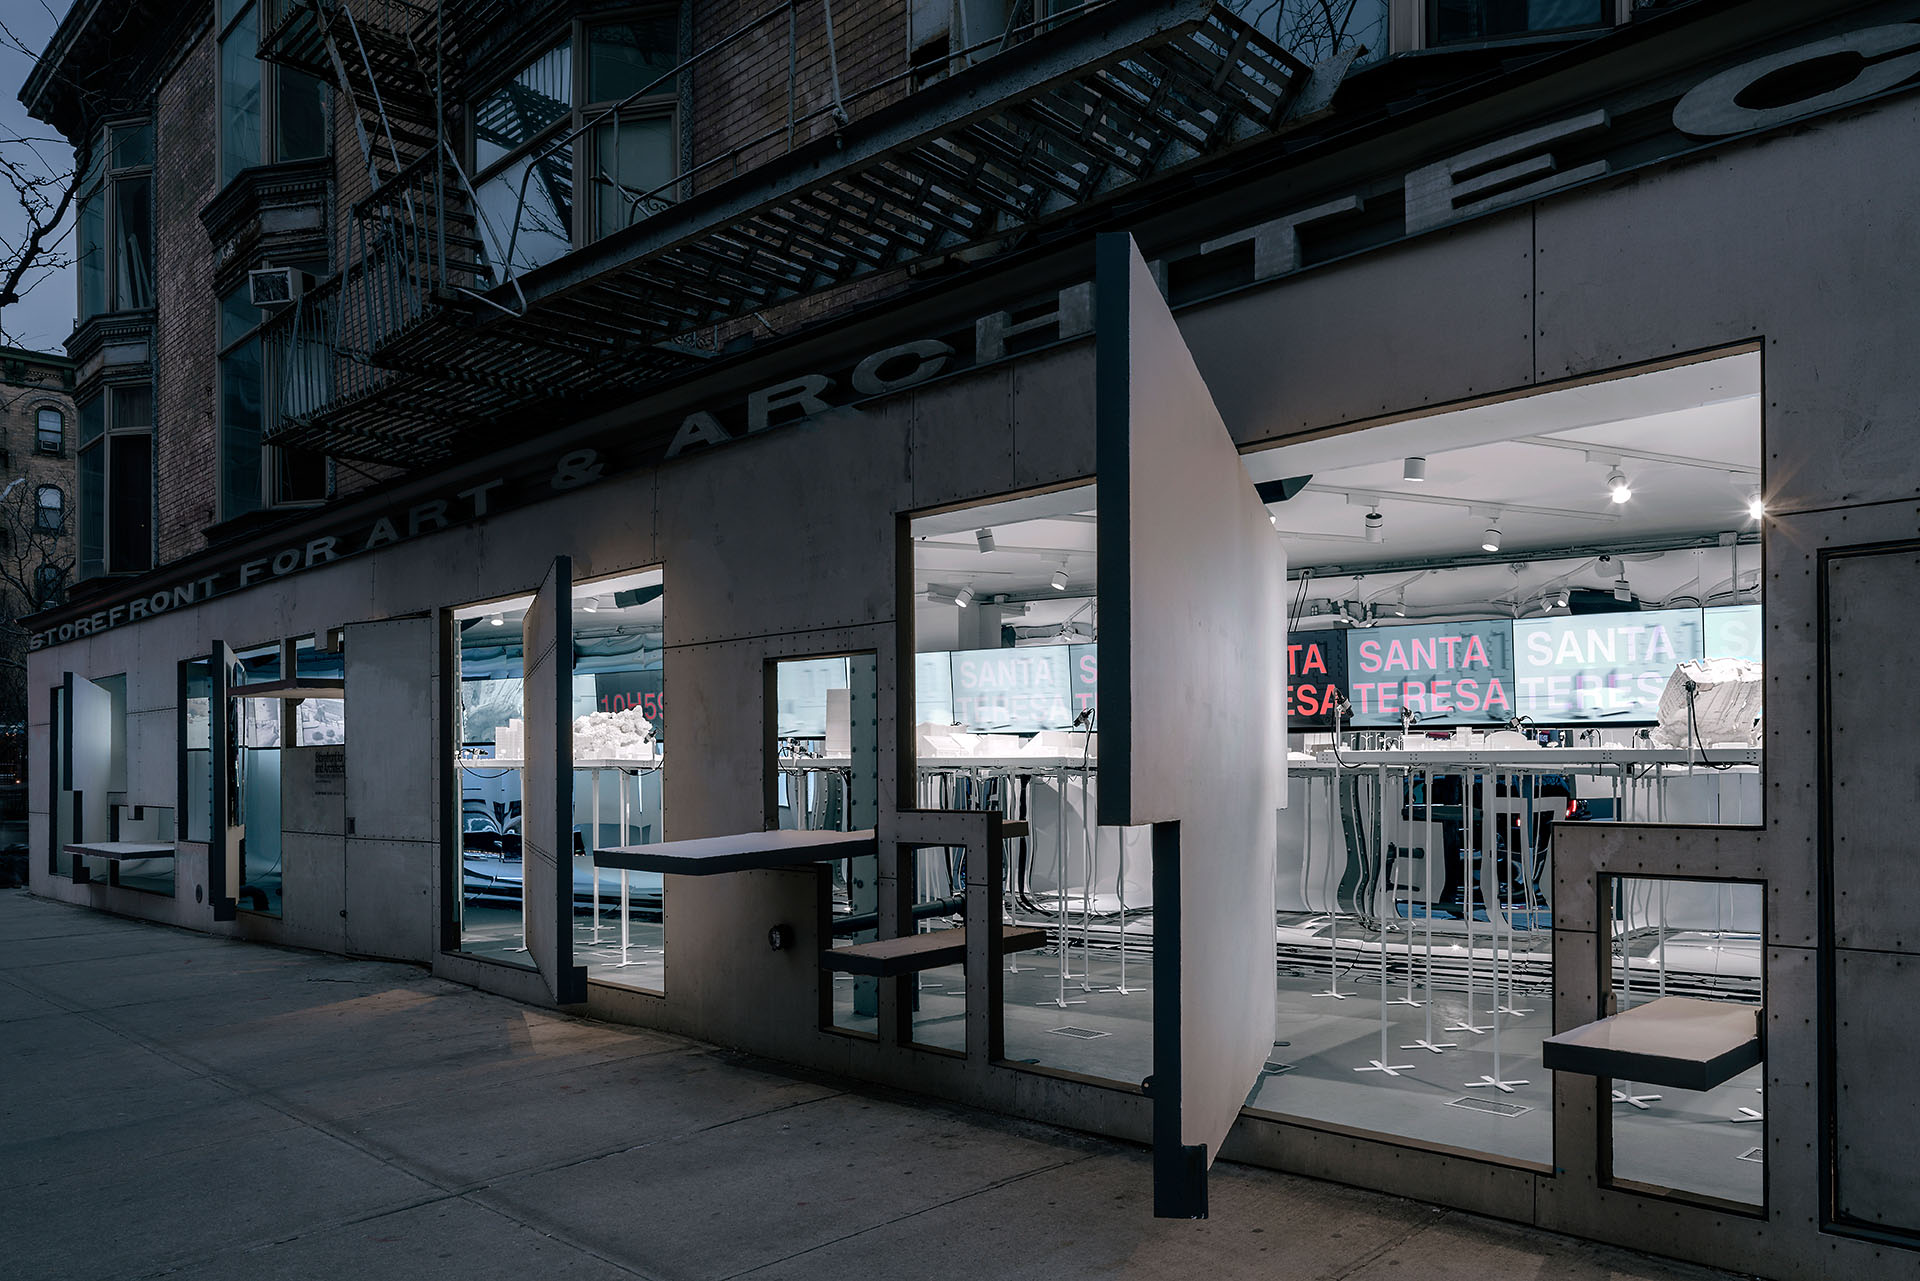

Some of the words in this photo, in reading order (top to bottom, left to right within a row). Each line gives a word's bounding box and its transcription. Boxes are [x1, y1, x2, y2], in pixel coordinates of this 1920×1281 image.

[29, 571, 223, 651] STOREFRONT
[239, 536, 339, 588] FOR
[365, 478, 504, 549] ART
[549, 448, 607, 494] &
[1360, 635, 1490, 673] SANTA
[1527, 625, 1677, 666] SANTA
[960, 658, 1054, 689] SANTA
[1518, 671, 1665, 714] TERES
[1353, 679, 1510, 715] TERESA
